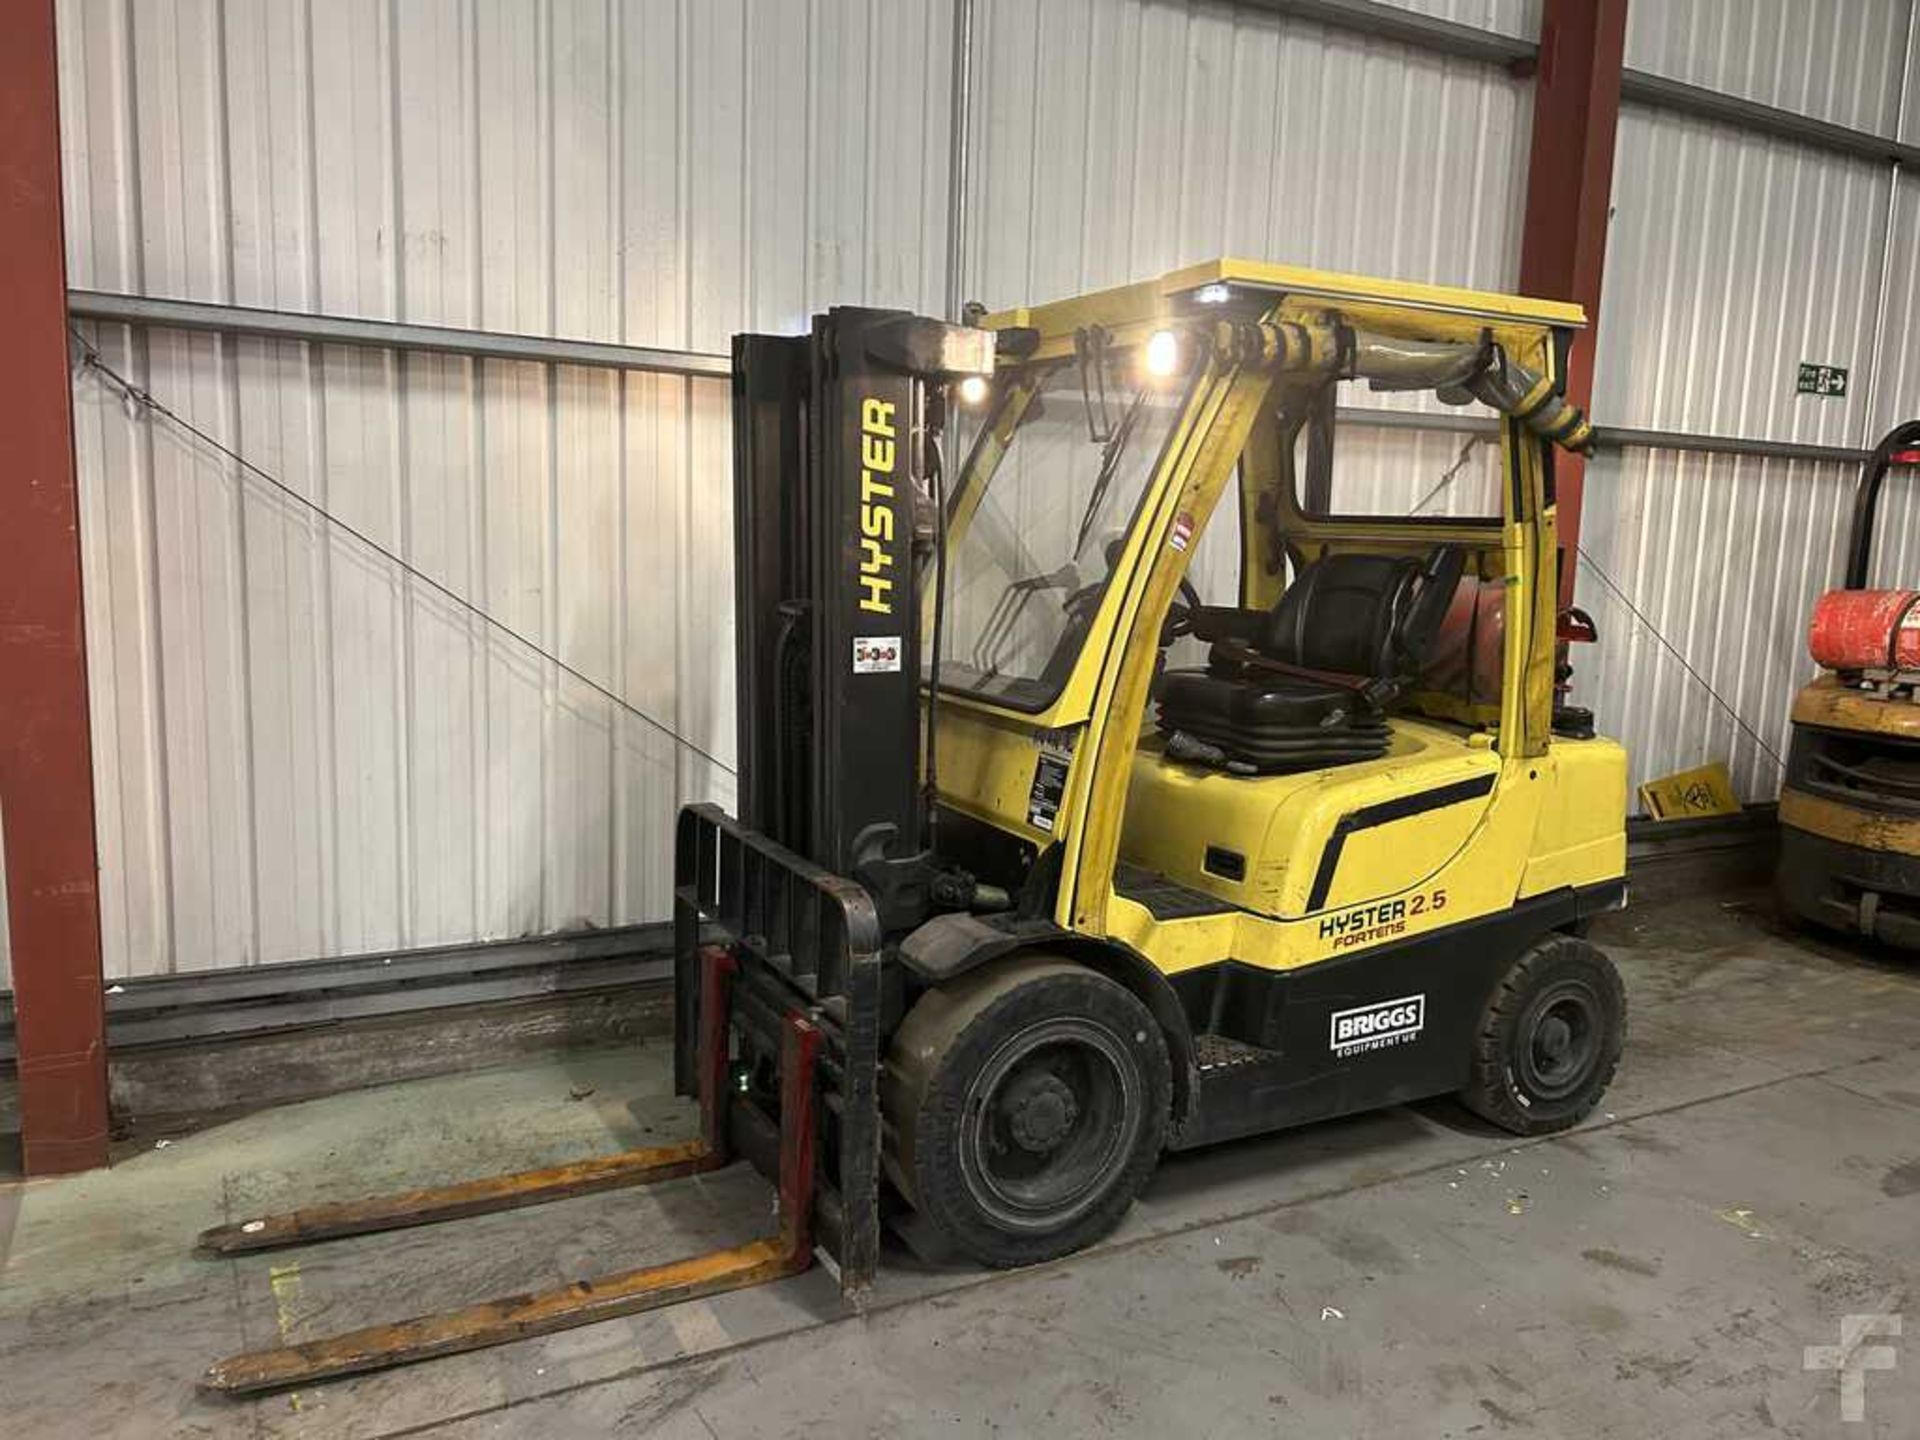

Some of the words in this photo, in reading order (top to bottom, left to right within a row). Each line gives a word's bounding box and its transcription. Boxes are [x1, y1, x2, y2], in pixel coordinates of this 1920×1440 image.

[859, 398, 896, 615] HYSTER
[1319, 899, 1407, 940] HYSTER
[1409, 889, 1447, 916] 2.5
[1337, 1003, 1418, 1041] BRIGGS
[1336, 1034, 1400, 1059] EQUIPMENT
